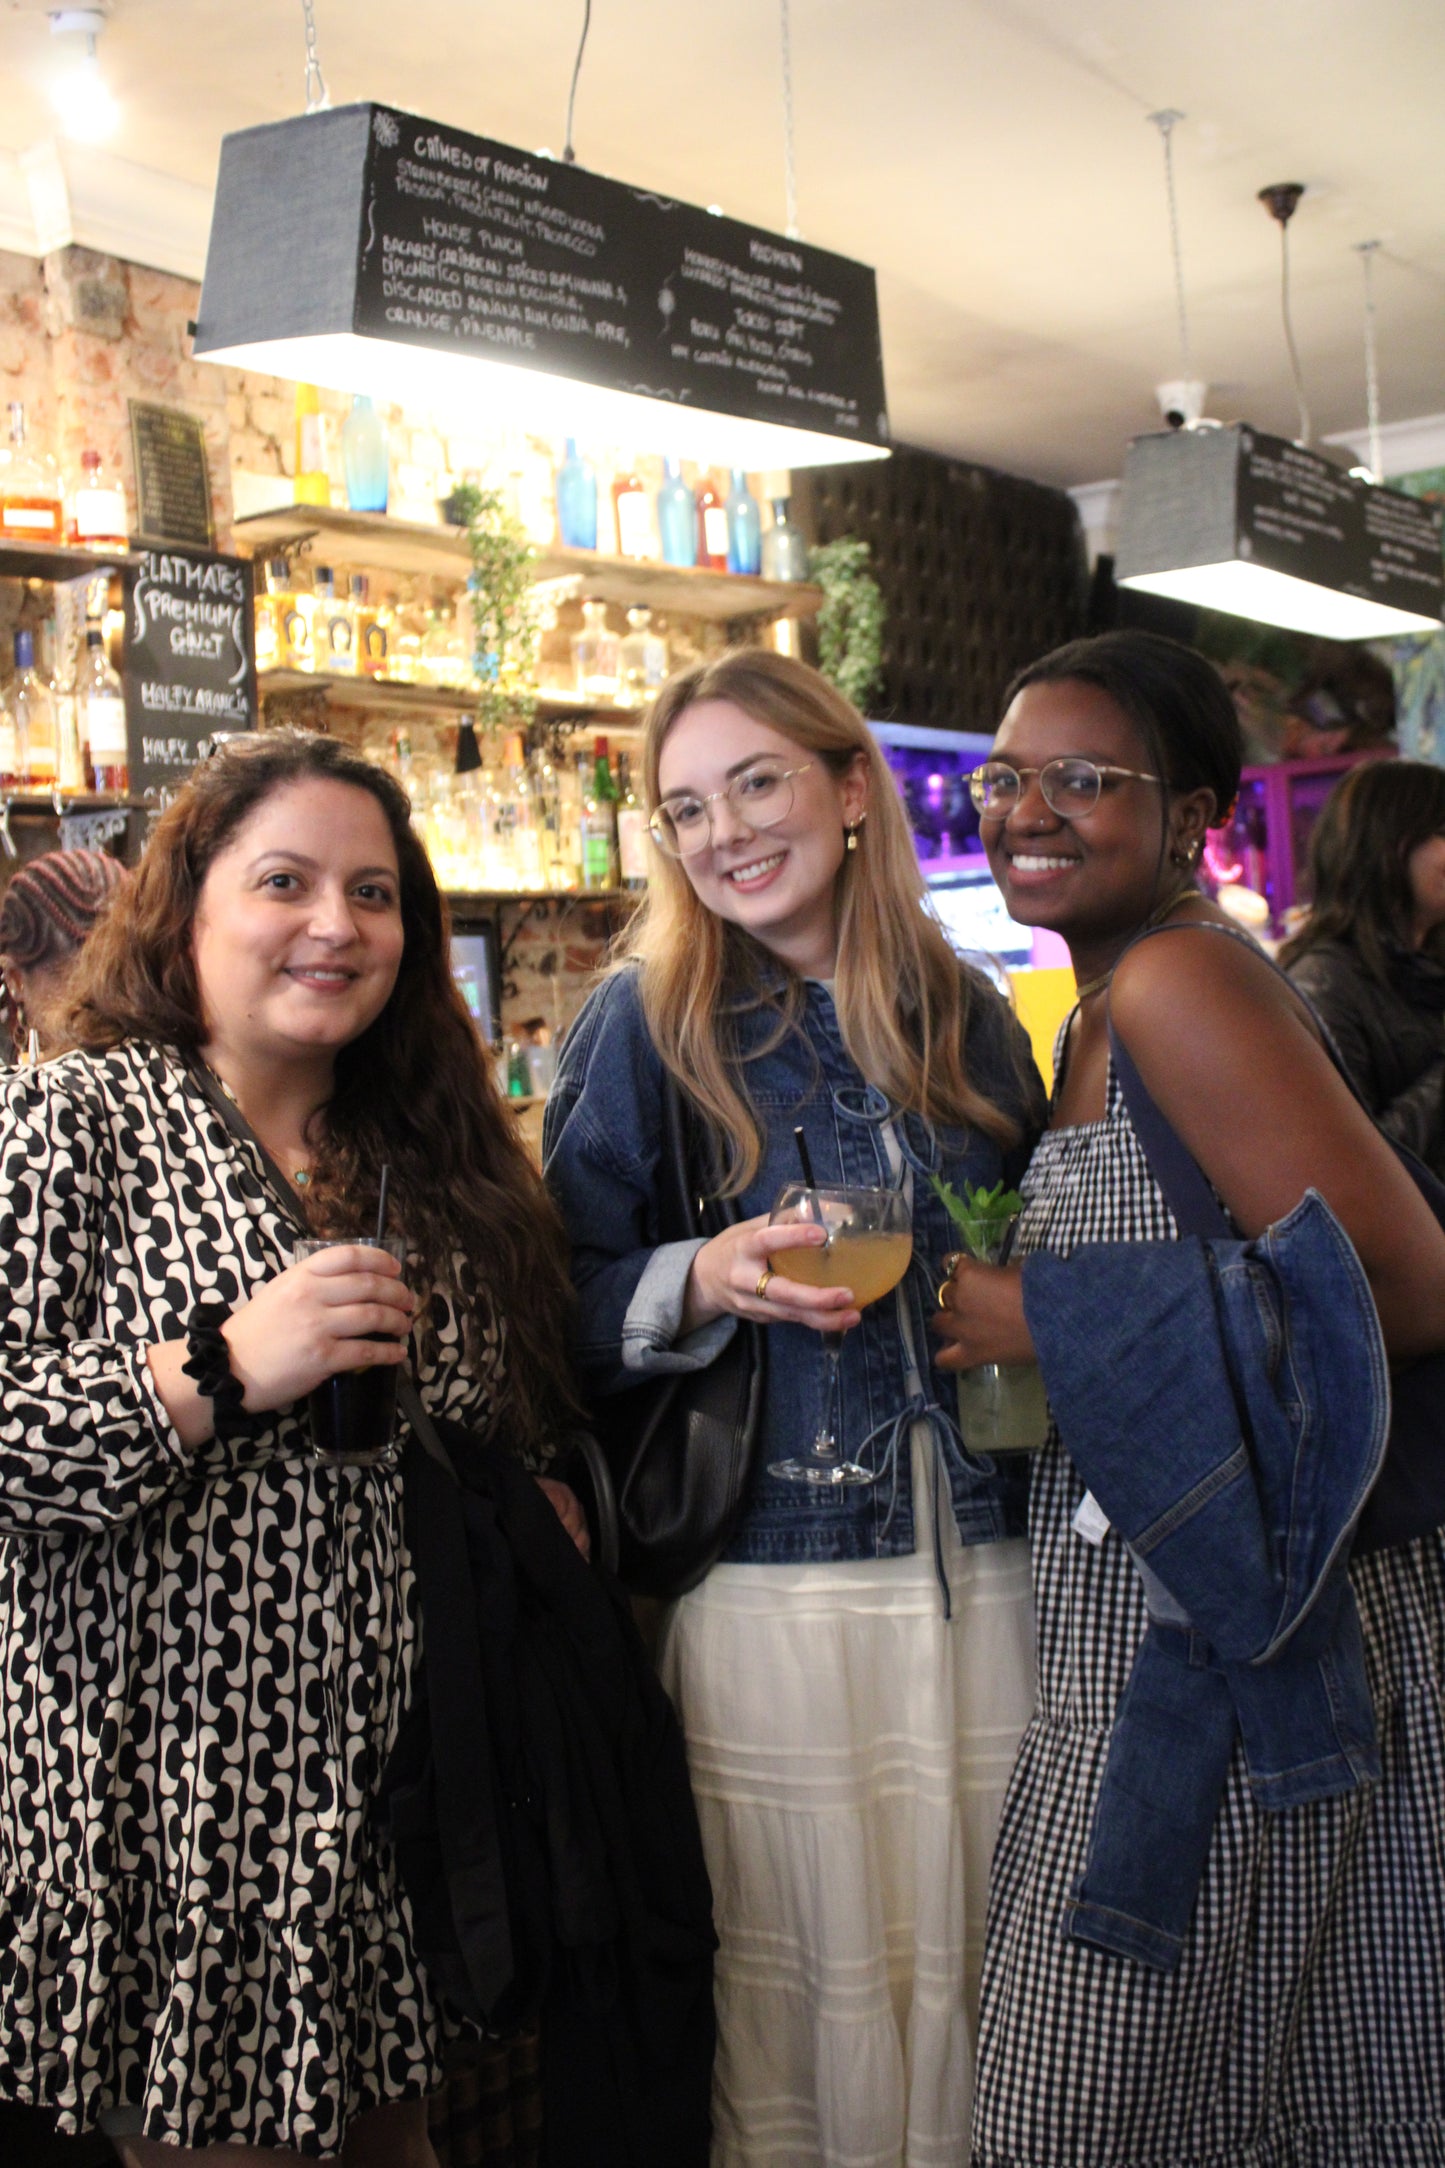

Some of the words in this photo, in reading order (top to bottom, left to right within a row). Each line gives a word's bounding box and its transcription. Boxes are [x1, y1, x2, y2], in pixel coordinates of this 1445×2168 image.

[414, 134, 473, 169] CRIMES
[474, 156, 491, 175] OF
[494, 160, 550, 192] PASSION
[382, 234, 437, 261] BACARDI
[422, 216, 472, 244] HOUSE
[478, 229, 524, 257] PUNCH
[382, 274, 463, 310] DISCARDED
[467, 295, 522, 321] BANANA
[461, 314, 537, 350] PINEAPPLE
[144, 589, 231, 628] PREMIUM
